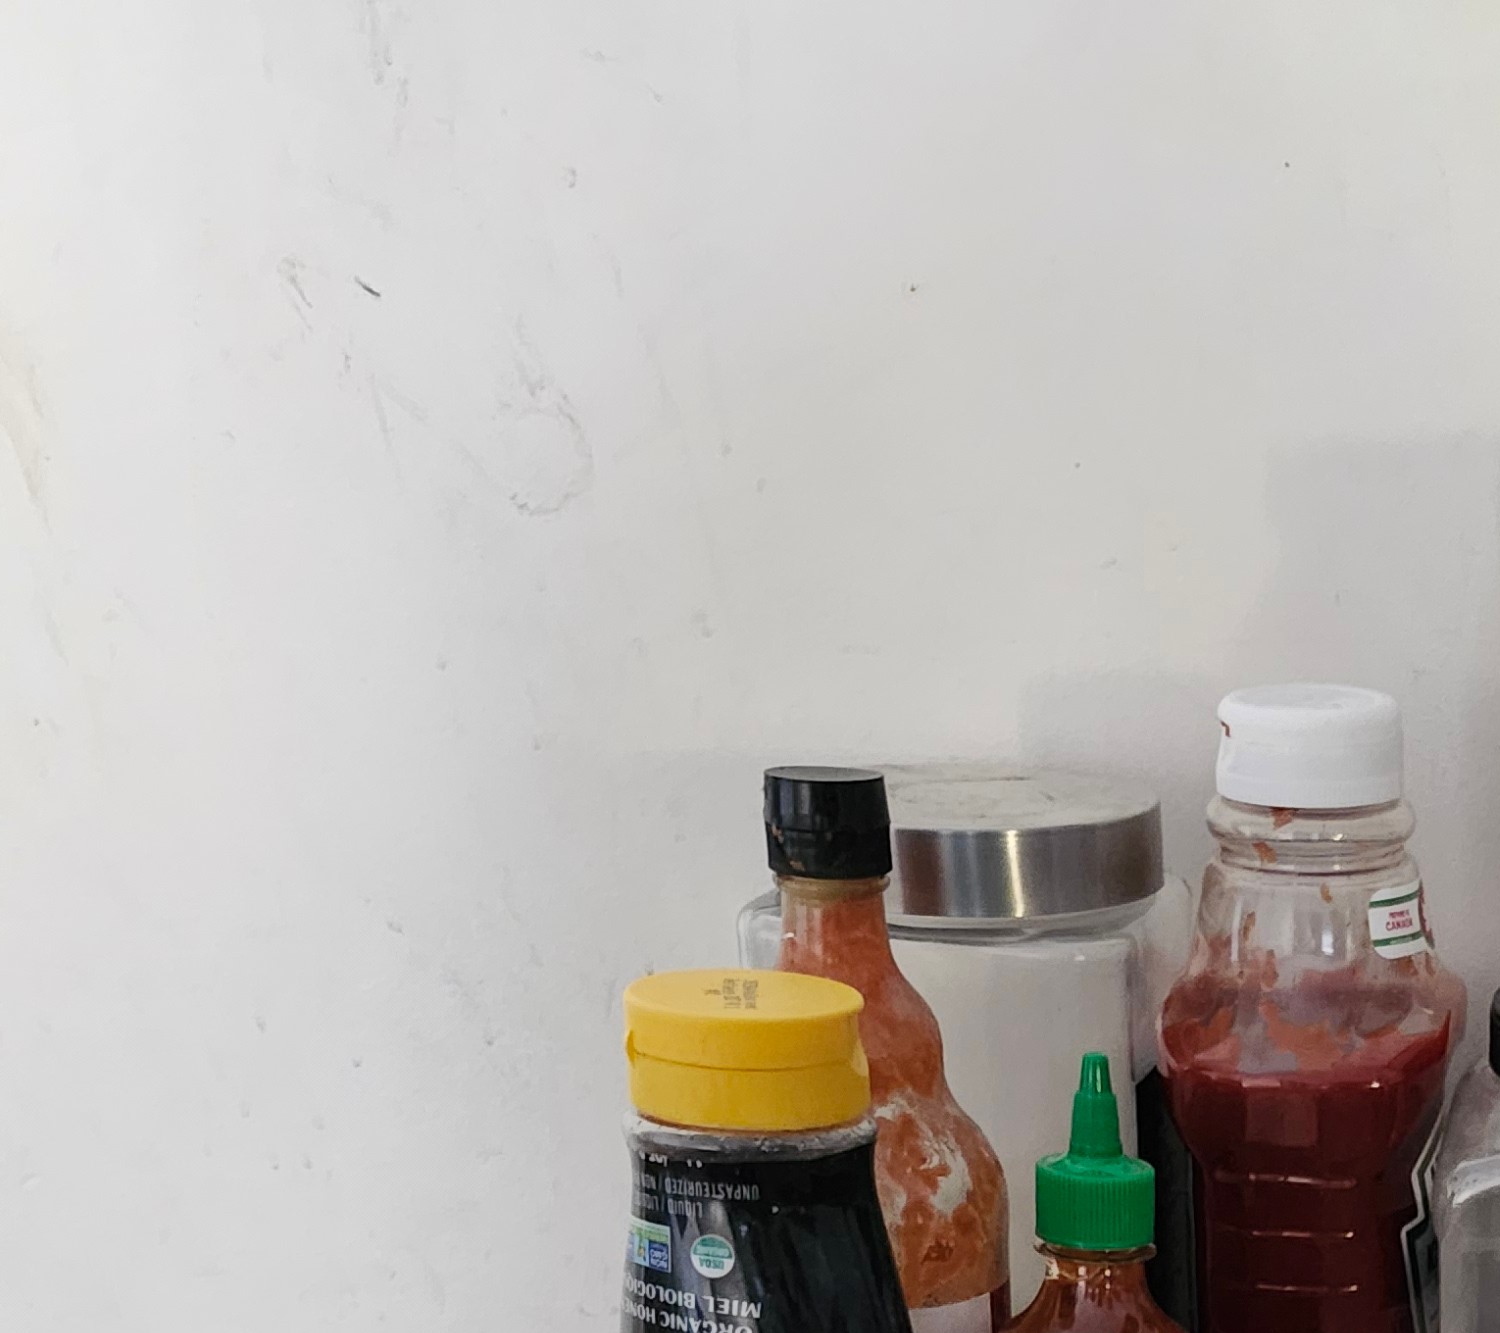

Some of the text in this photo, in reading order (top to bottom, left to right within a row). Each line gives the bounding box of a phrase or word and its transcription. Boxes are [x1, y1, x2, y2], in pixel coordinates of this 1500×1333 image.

[664, 1177, 759, 1200] UNPASTEURIZED
[667, 1199, 703, 1218] LIQUID
[623, 1271, 762, 1319] MIEL BIOLOGIQ
[622, 1297, 657, 1325] HONE
